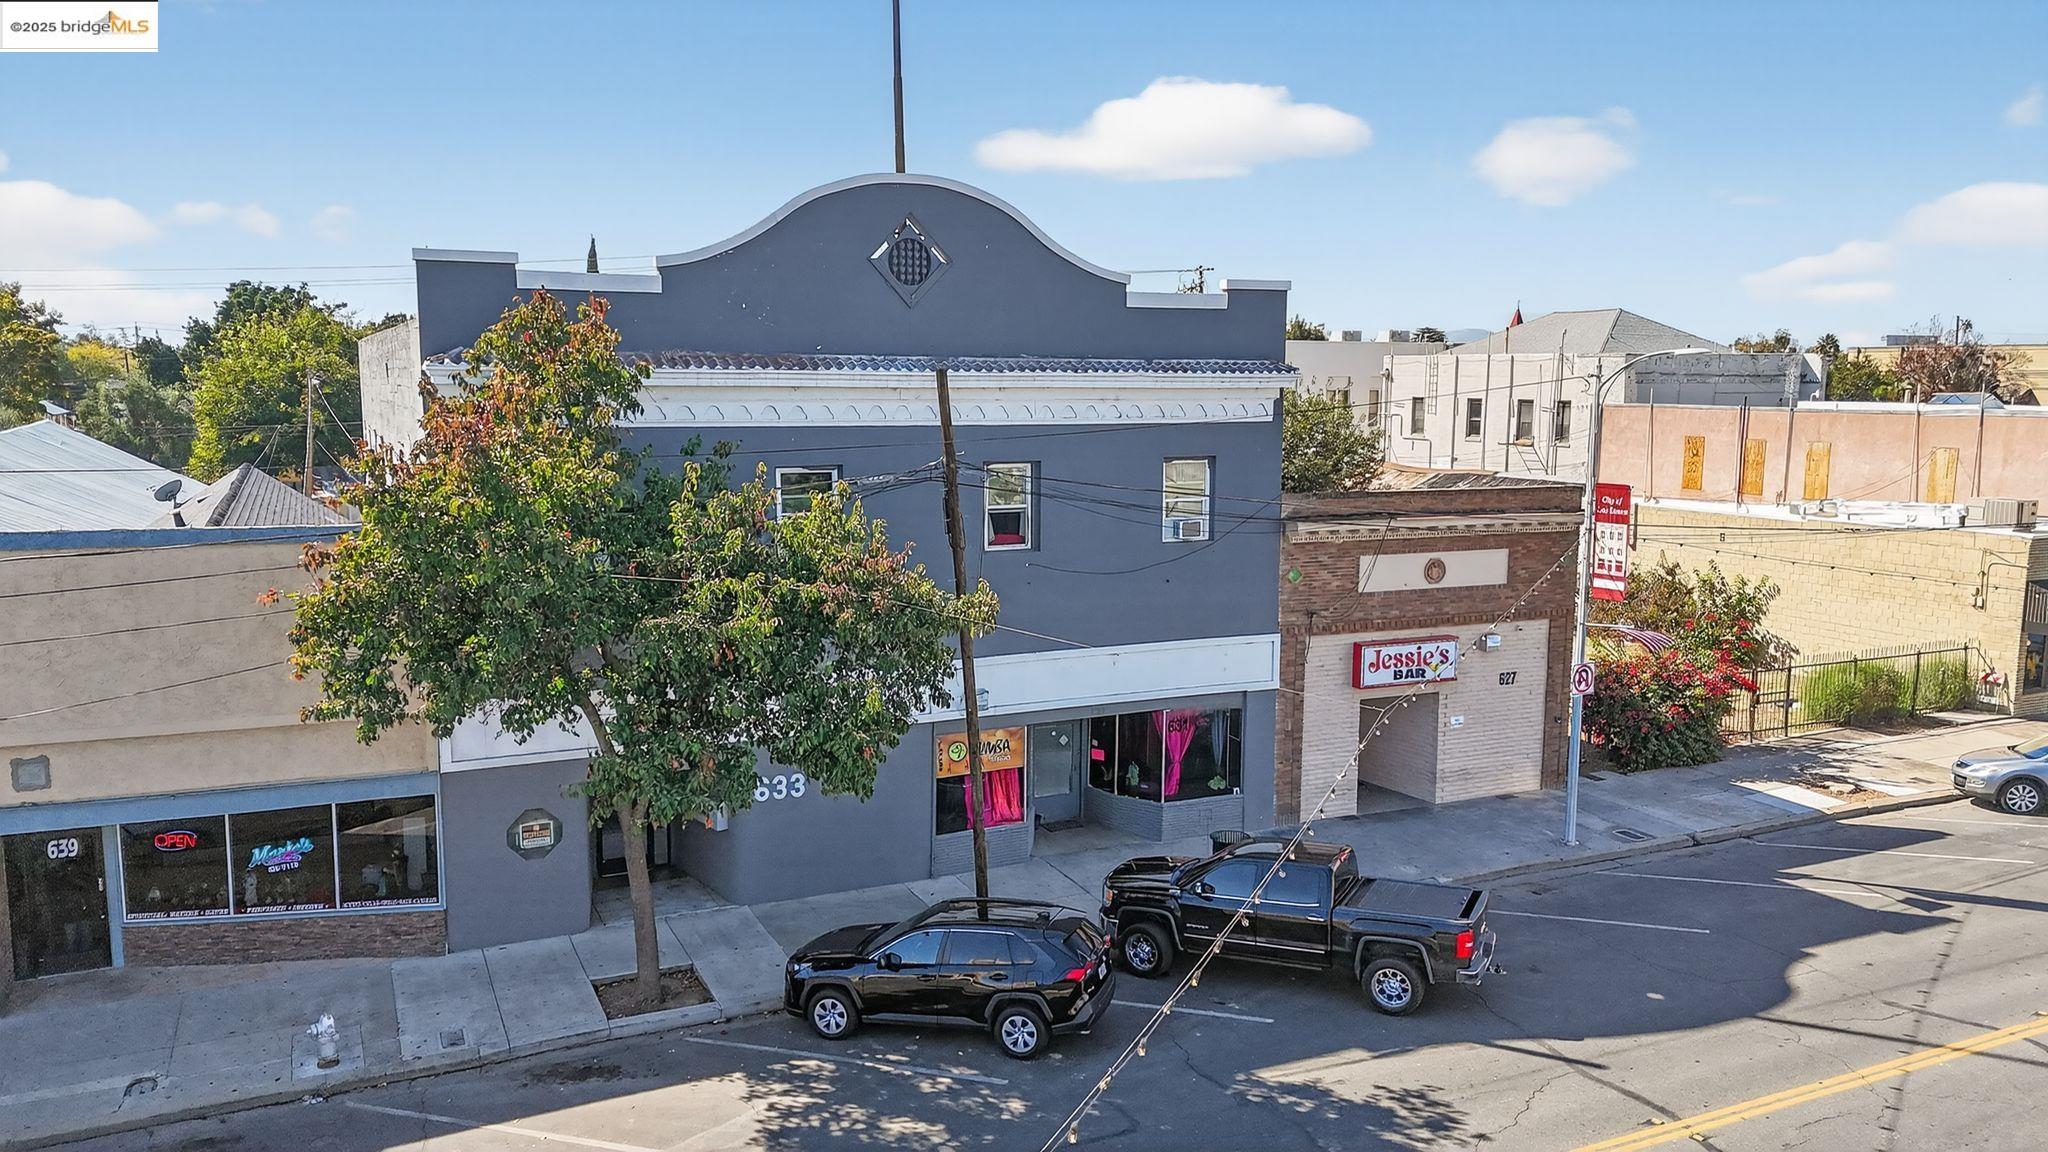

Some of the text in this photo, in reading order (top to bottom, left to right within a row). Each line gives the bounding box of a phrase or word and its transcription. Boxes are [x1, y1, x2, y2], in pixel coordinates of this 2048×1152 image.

[1368, 645, 1450, 674] Jessie's
[1393, 668, 1426, 680] BAR
[1499, 671, 1517, 685] 627
[978, 739, 1011, 755] UMBA
[754, 773, 806, 802] 633
[47, 838, 79, 859] 639
[154, 834, 197, 849] OPEN
